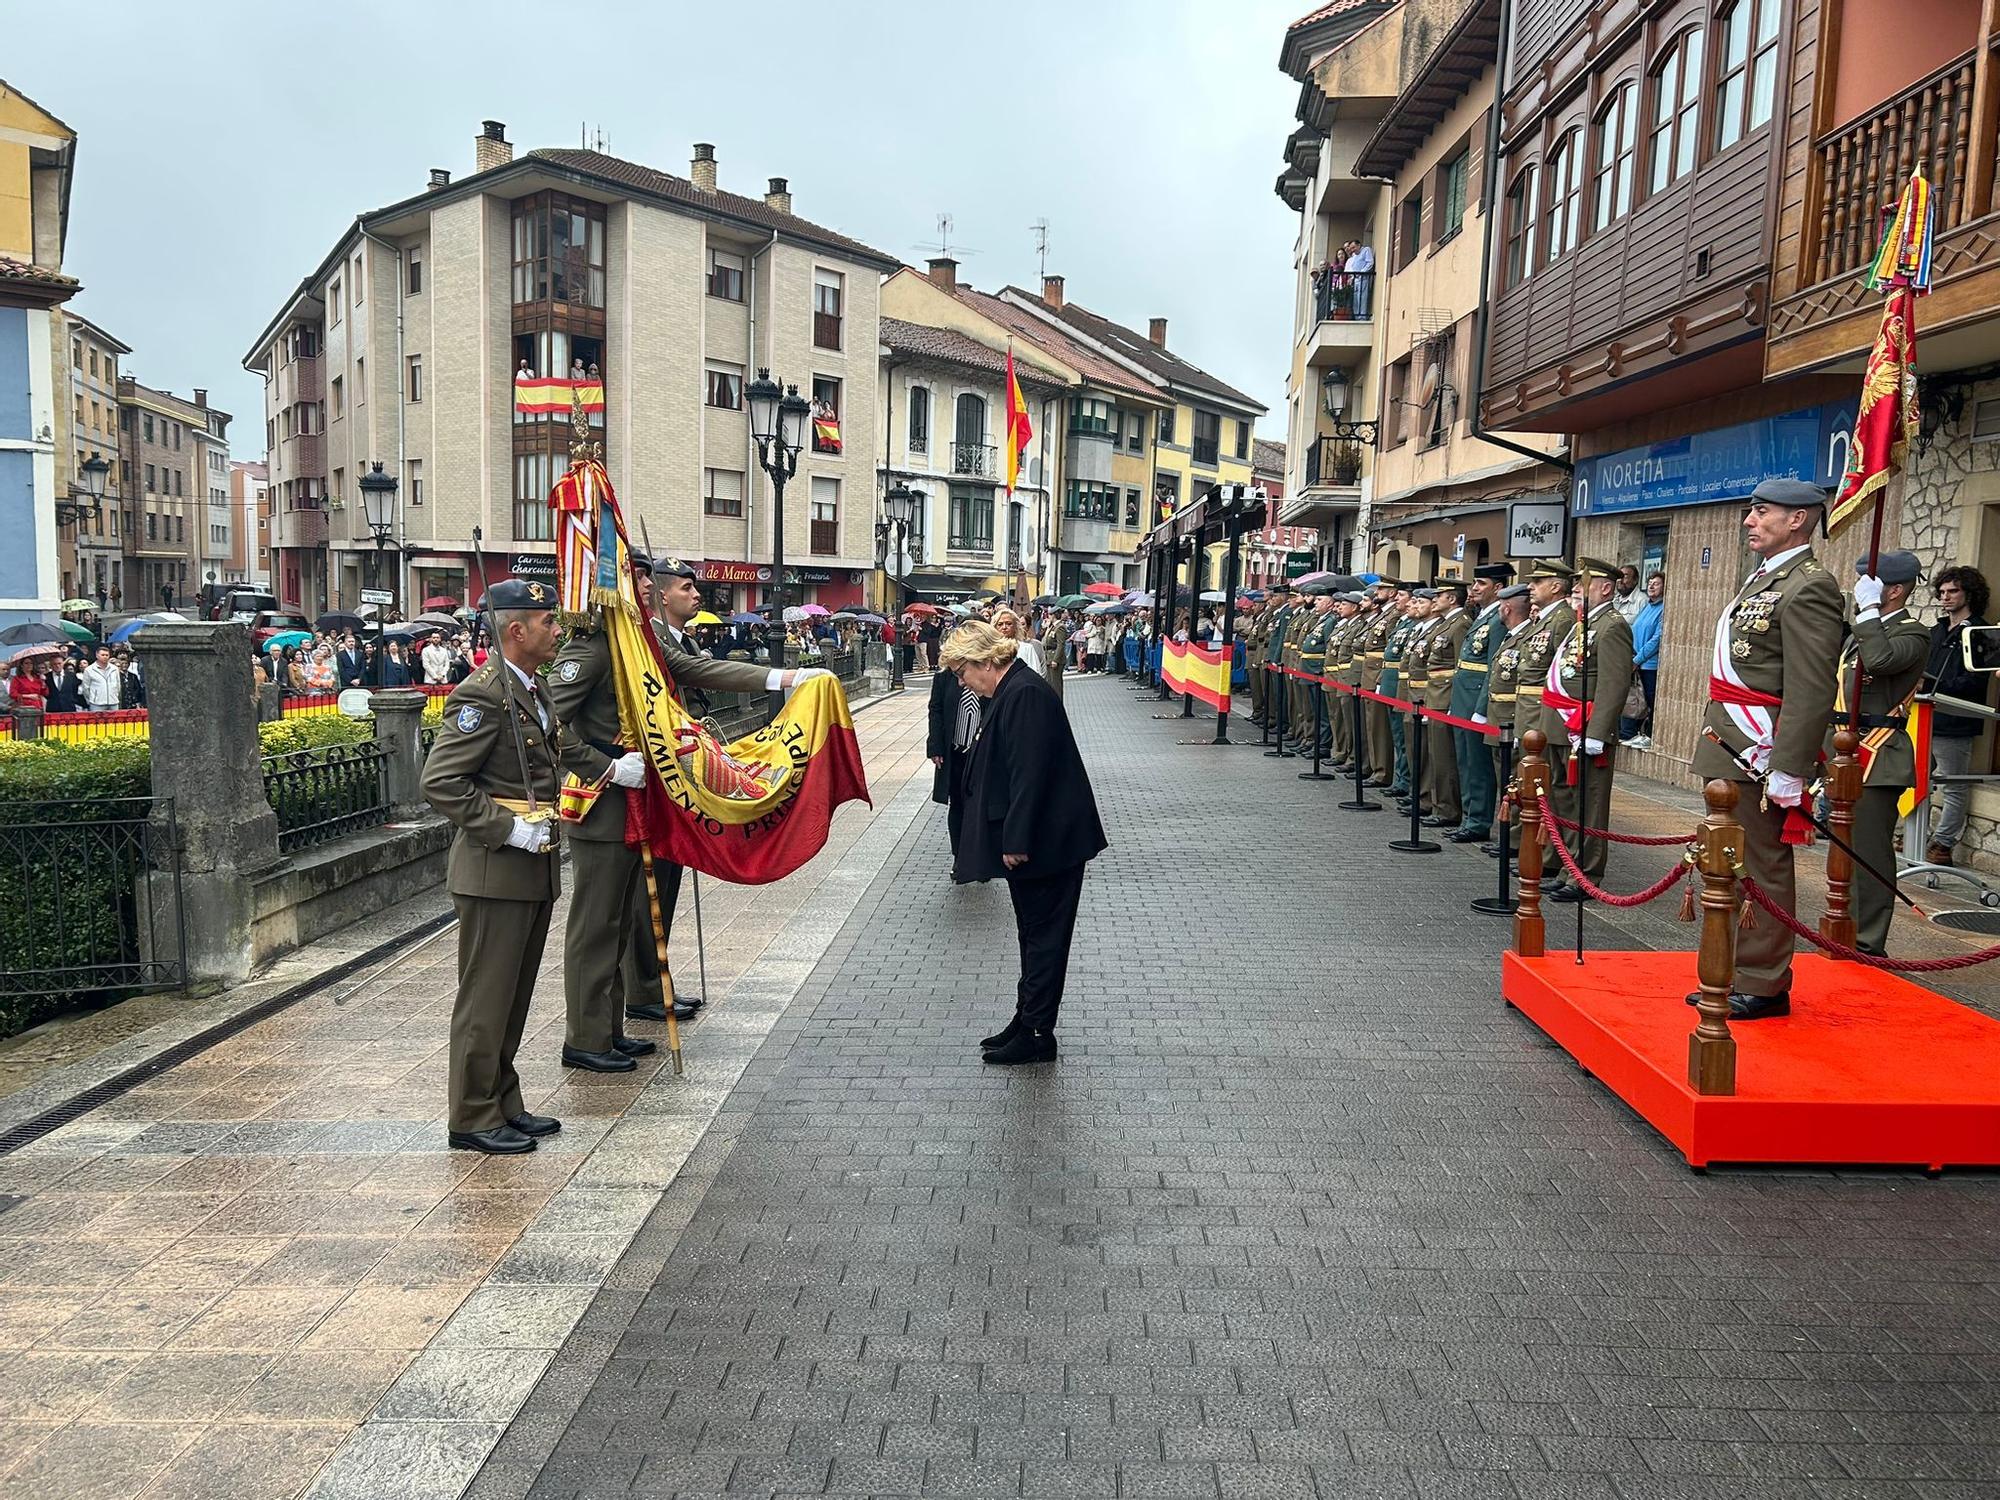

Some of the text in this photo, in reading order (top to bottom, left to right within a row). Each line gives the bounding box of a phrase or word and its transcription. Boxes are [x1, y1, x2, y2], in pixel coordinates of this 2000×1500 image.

[1702, 480, 1722, 492] Locales
[1722, 475, 1758, 489] Comerciales
[1514, 523, 1560, 539] HATCHET
[706, 565, 719, 579] de
[722, 566, 756, 581] Marco
